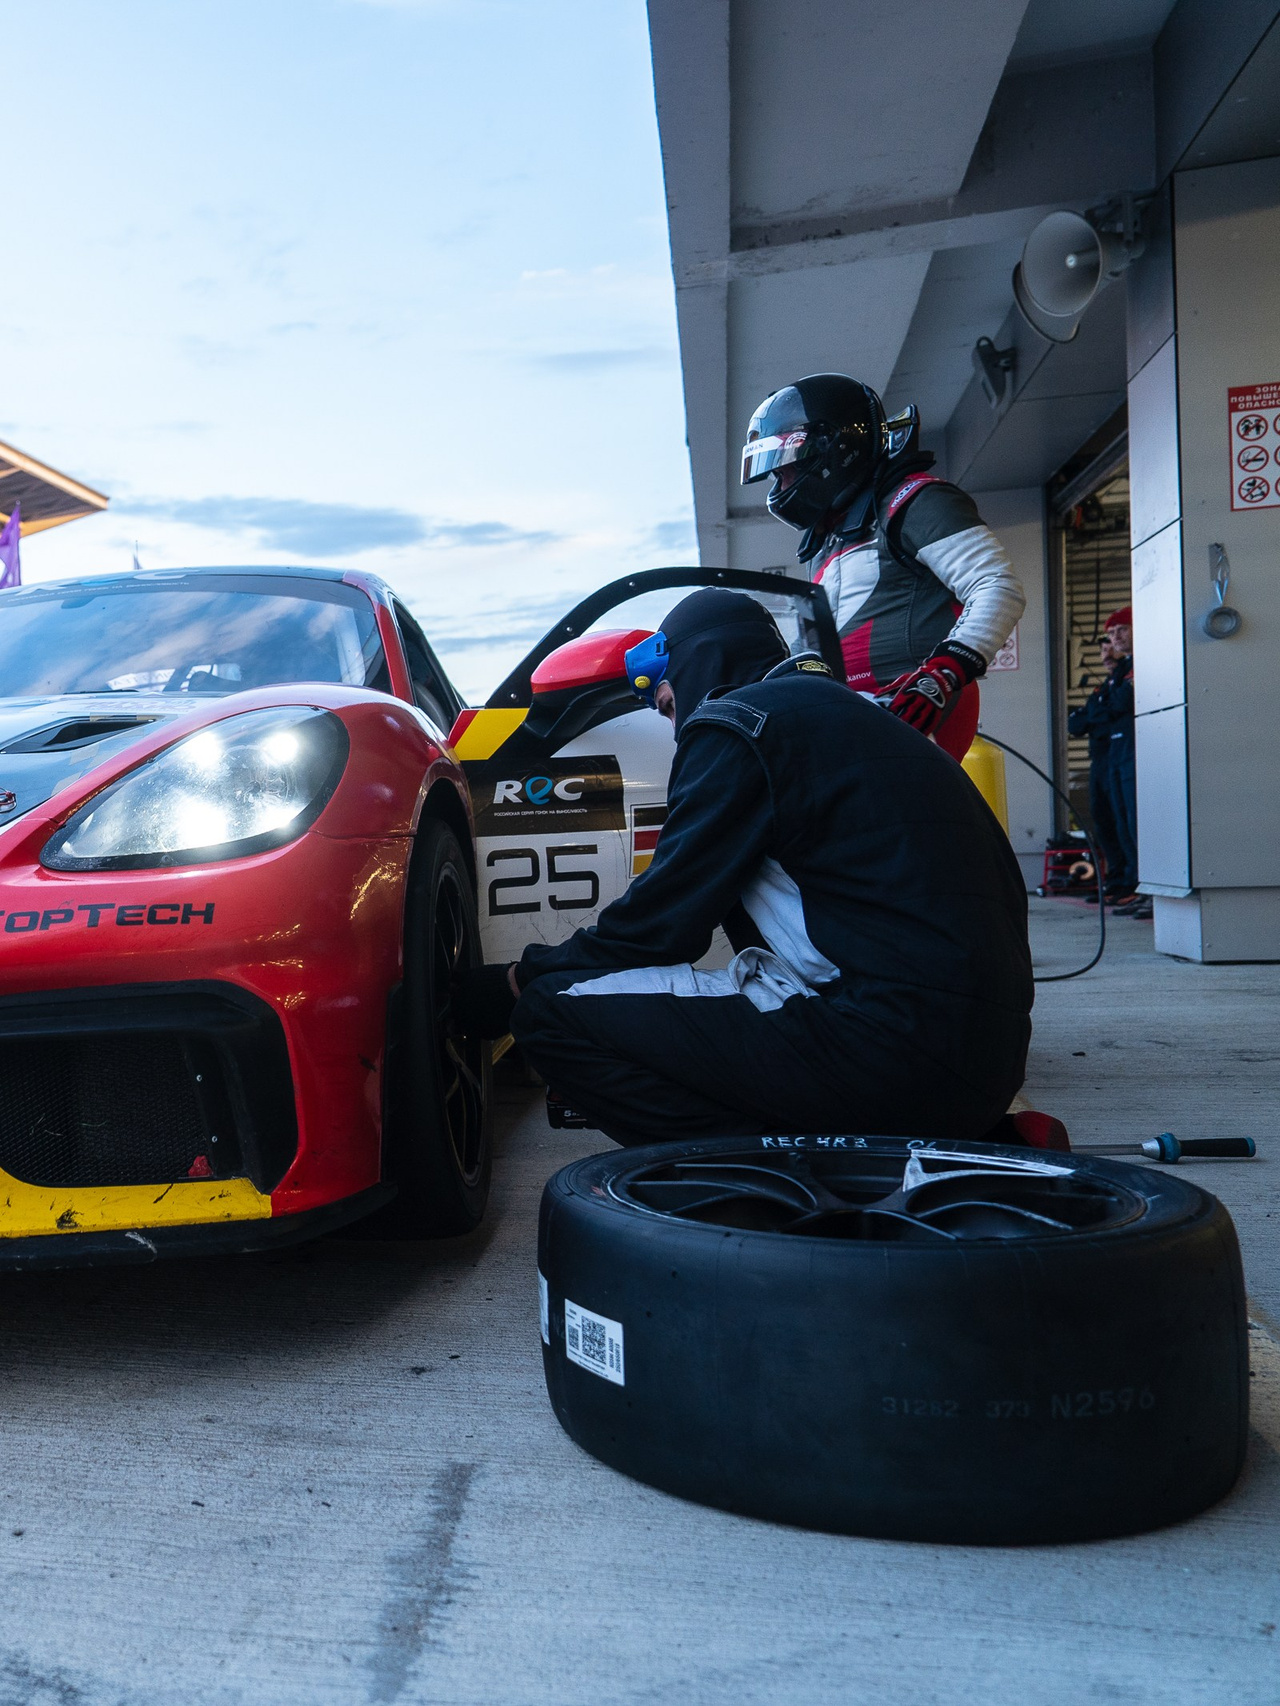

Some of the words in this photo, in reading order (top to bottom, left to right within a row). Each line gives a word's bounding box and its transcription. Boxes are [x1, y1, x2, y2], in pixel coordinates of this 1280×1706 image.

[1256, 384, 1280, 393] ЗОН
[846, 671, 872, 683] kanov
[487, 844, 600, 916] 25
[762, 1136, 806, 1148] REC
[1051, 1387, 1156, 1420] N2596
